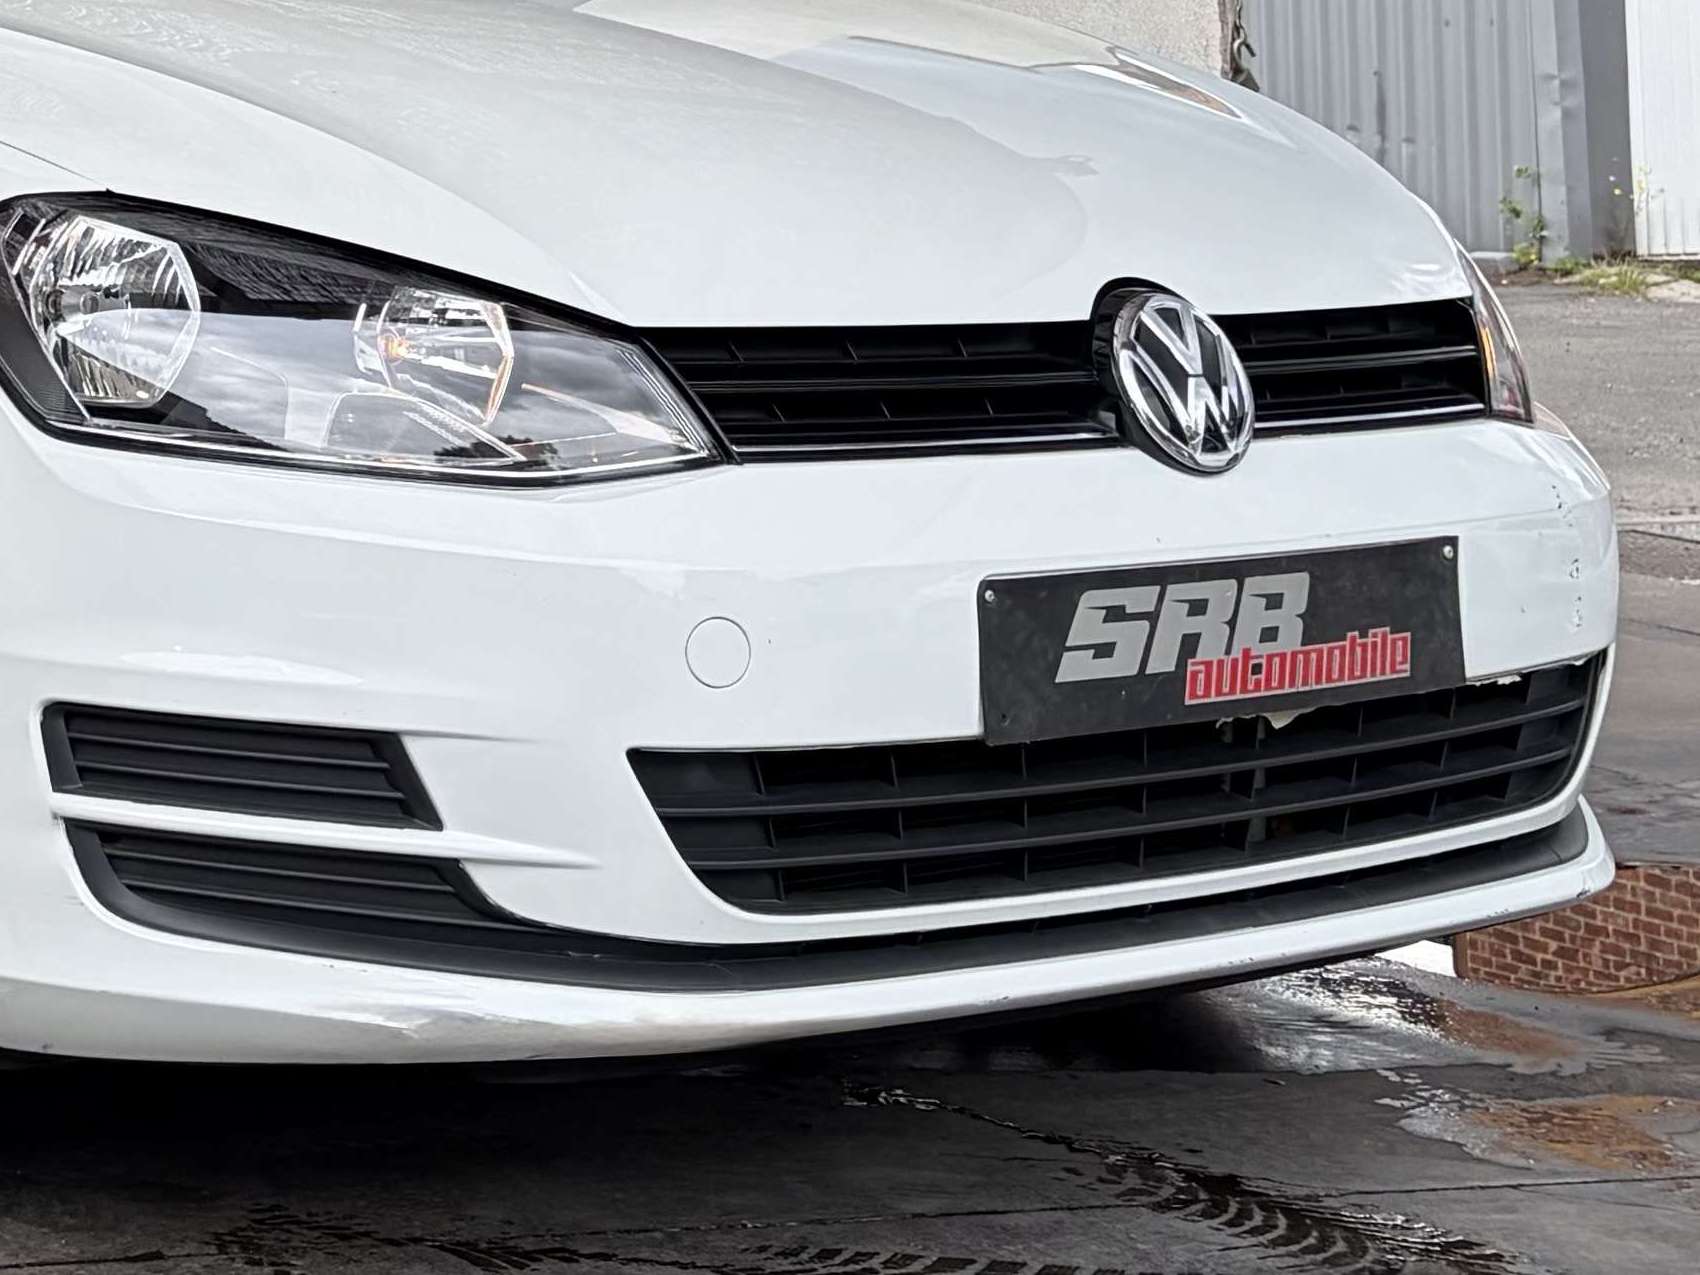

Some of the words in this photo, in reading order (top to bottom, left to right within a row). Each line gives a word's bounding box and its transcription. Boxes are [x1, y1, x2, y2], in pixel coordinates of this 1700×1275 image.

[1120, 299, 1248, 463] VW
[1055, 571, 1310, 683] SRB
[1184, 626, 1412, 705] automobile
